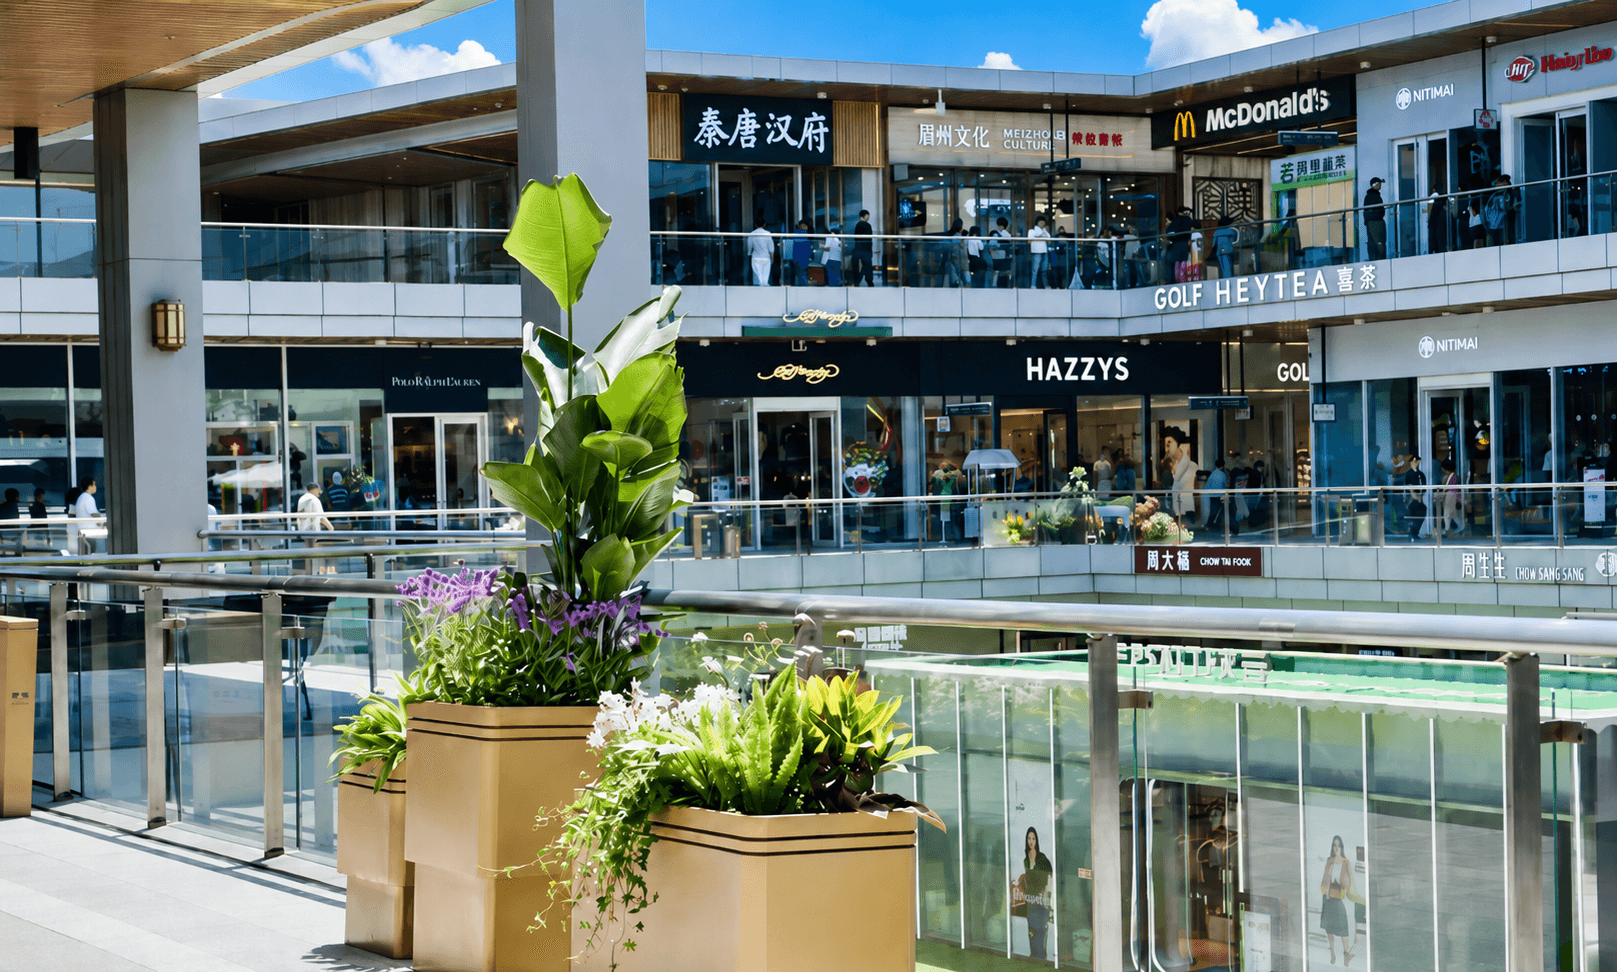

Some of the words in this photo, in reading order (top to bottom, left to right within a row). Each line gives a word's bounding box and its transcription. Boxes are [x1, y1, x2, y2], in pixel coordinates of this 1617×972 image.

[1413, 83, 1454, 102] NITIMAI
[1205, 88, 1332, 132] McDonald's
[694, 106, 829, 153] 秦唐汉府
[918, 124, 990, 148] 眉州文化
[1216, 270, 1328, 305] HEYTEA
[1337, 265, 1376, 293] 喜茶
[1154, 283, 1202, 310] GOLF
[1436, 336, 1478, 352] NITIMAI
[1026, 356, 1130, 381] HAZZYS
[1461, 551, 1507, 579] 周生生
[1515, 567, 1537, 580] CHOW
[1538, 567, 1562, 581] SANG
[1562, 568, 1585, 581] SANG
